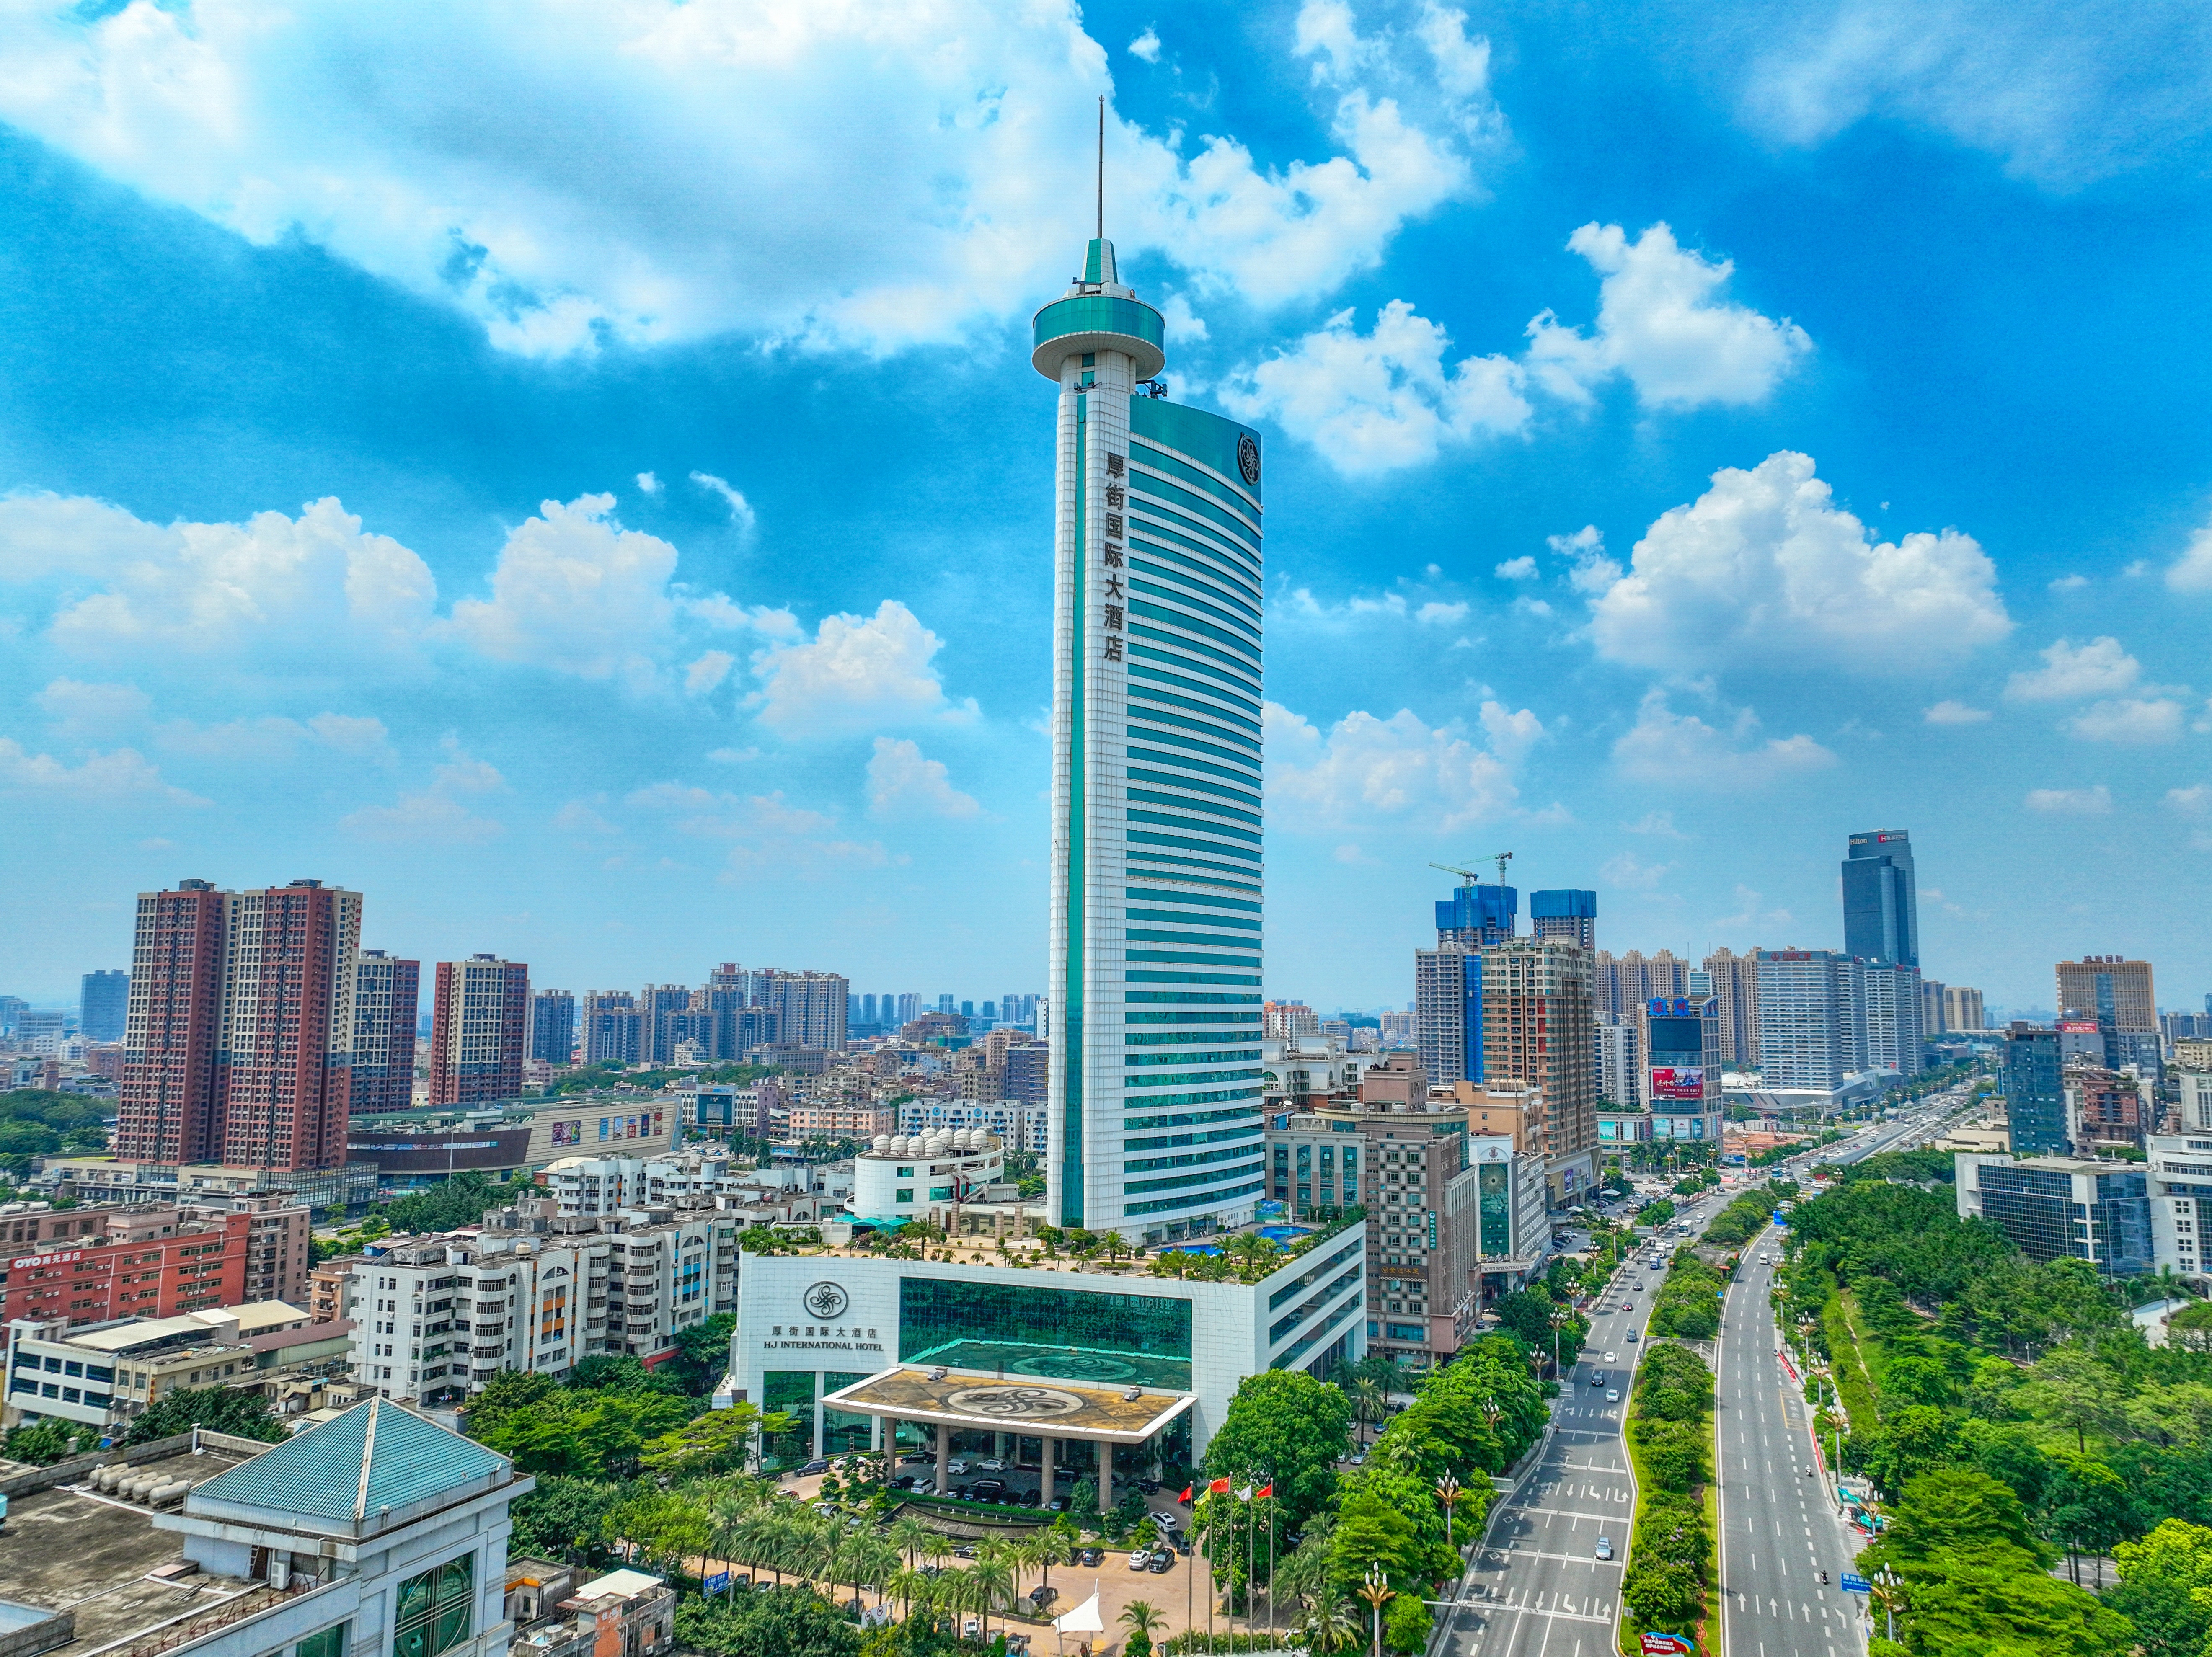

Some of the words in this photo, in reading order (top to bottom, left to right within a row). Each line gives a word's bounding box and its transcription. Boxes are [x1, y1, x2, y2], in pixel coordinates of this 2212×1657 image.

[1104, 452, 1124, 662] 厚街国际大酒店
[353, 900, 362, 947] 万科城市广场
[14, 1257, 41, 1269] OYO
[772, 1326, 877, 1339] 厚街国际大酒店
[780, 1341, 852, 1350] INTERNATIONAL
[855, 1343, 884, 1352] HOTEL
